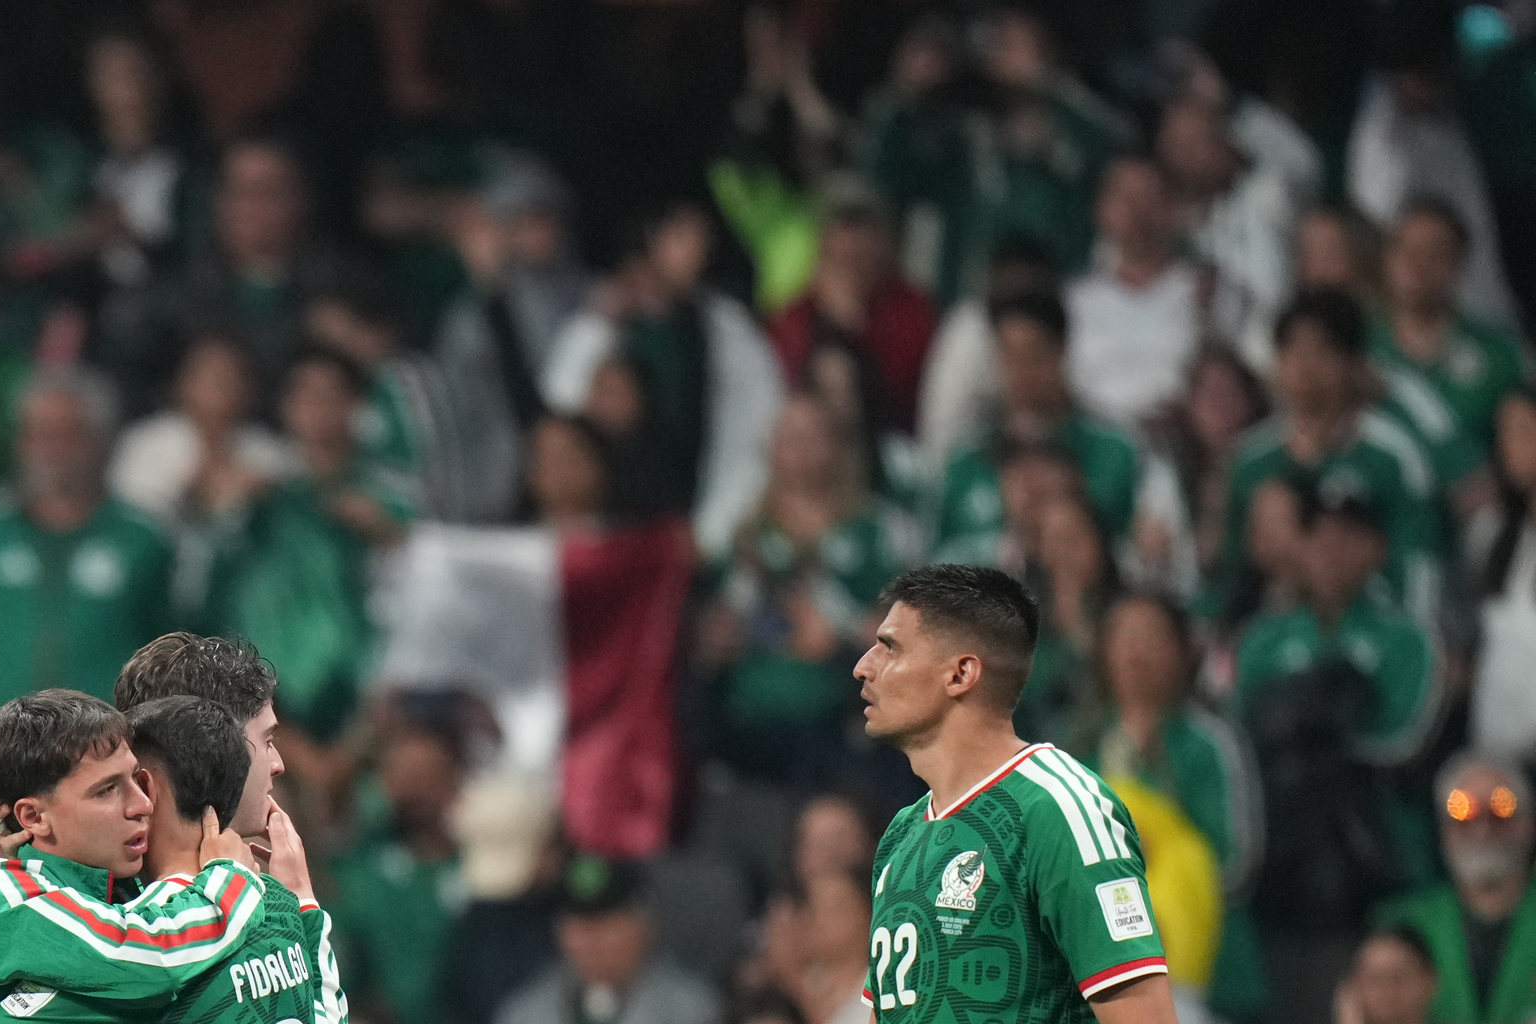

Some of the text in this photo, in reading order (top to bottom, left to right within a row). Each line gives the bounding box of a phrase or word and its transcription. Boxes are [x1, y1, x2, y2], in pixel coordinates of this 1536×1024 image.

[1114, 914, 1144, 928] EDUCATION
[229, 942, 310, 1004] FIDALGO
[871, 922, 918, 1011] 22
